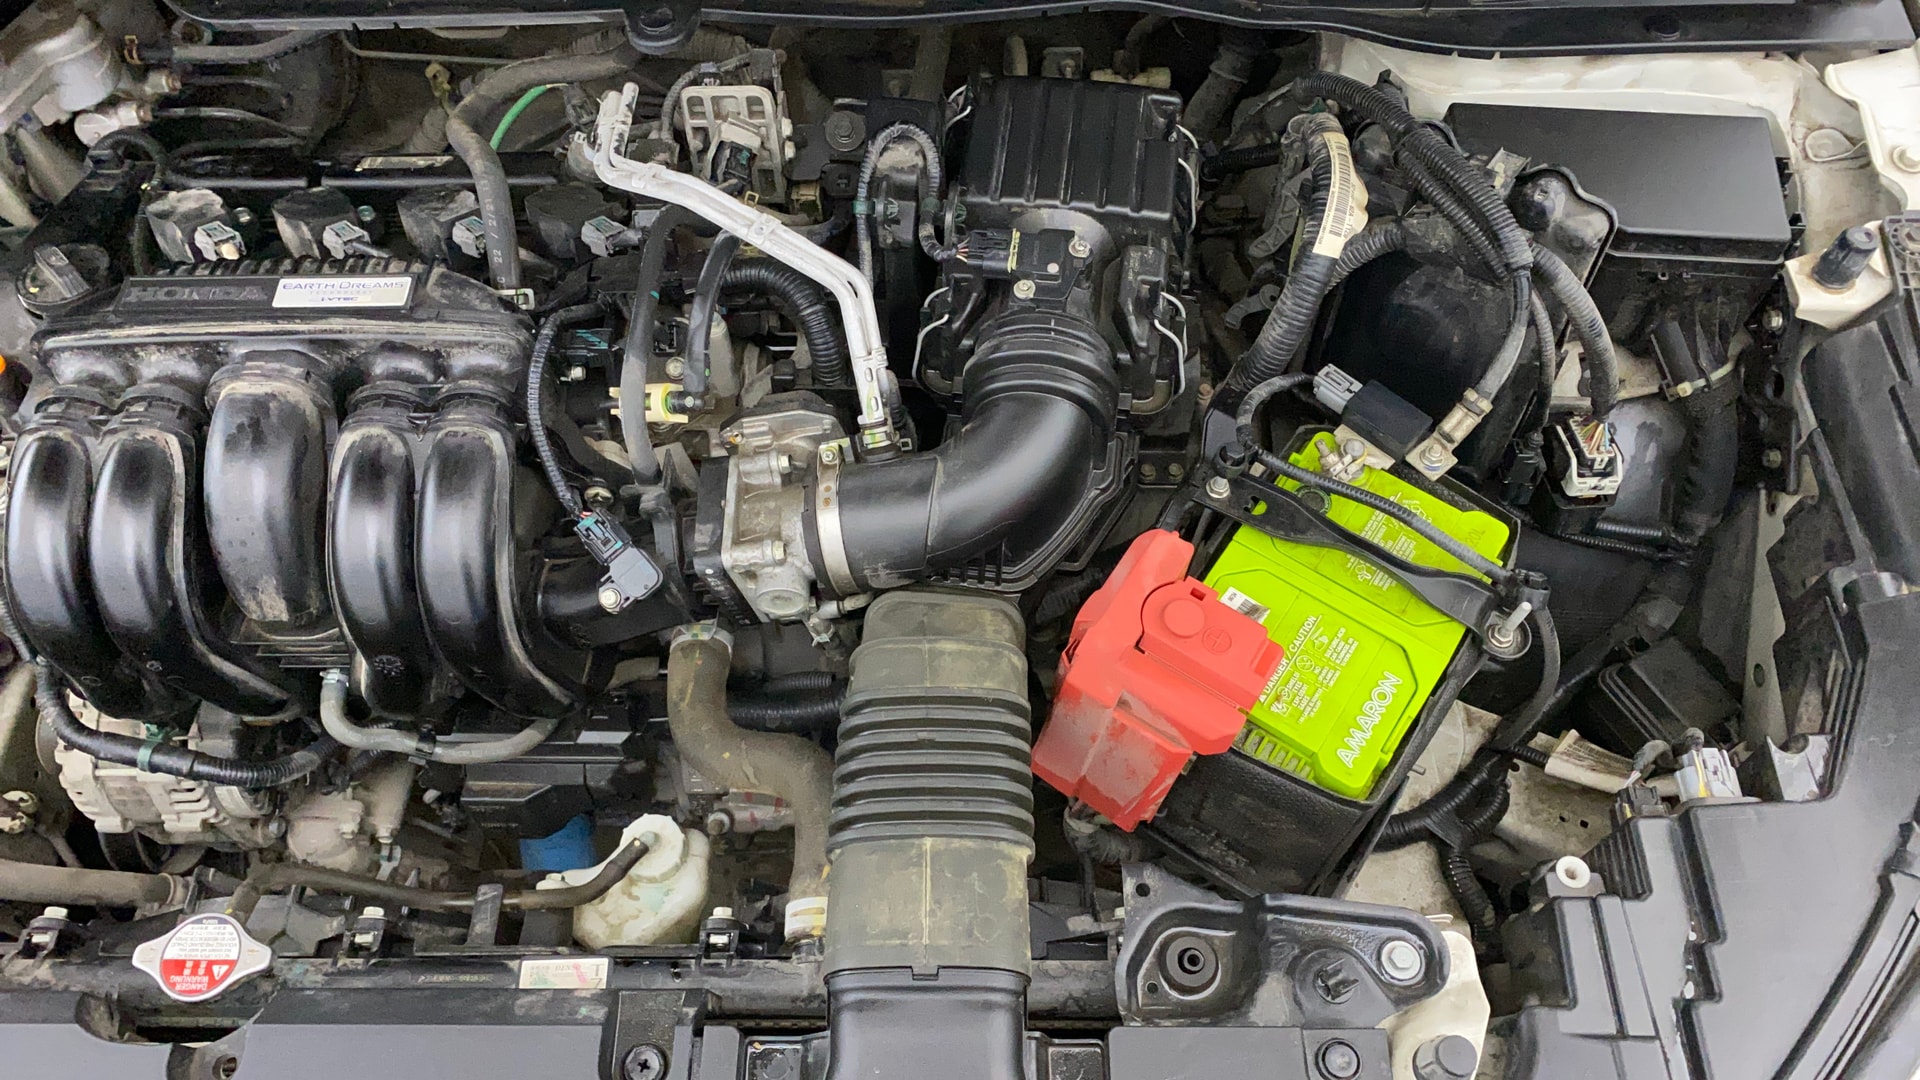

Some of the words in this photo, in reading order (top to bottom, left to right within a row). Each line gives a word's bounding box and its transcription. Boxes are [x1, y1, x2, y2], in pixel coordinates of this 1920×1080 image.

[282, 281, 336, 290] EARTH
[339, 280, 404, 290] DREAMS
[122, 286, 268, 302] HONDA
[1264, 659, 1290, 693] DANGER
[1287, 614, 1317, 653] CAUTION
[1336, 671, 1403, 768] AMARON
[169, 974, 208, 983] WARNUNG
[174, 982, 207, 991] DANGER
